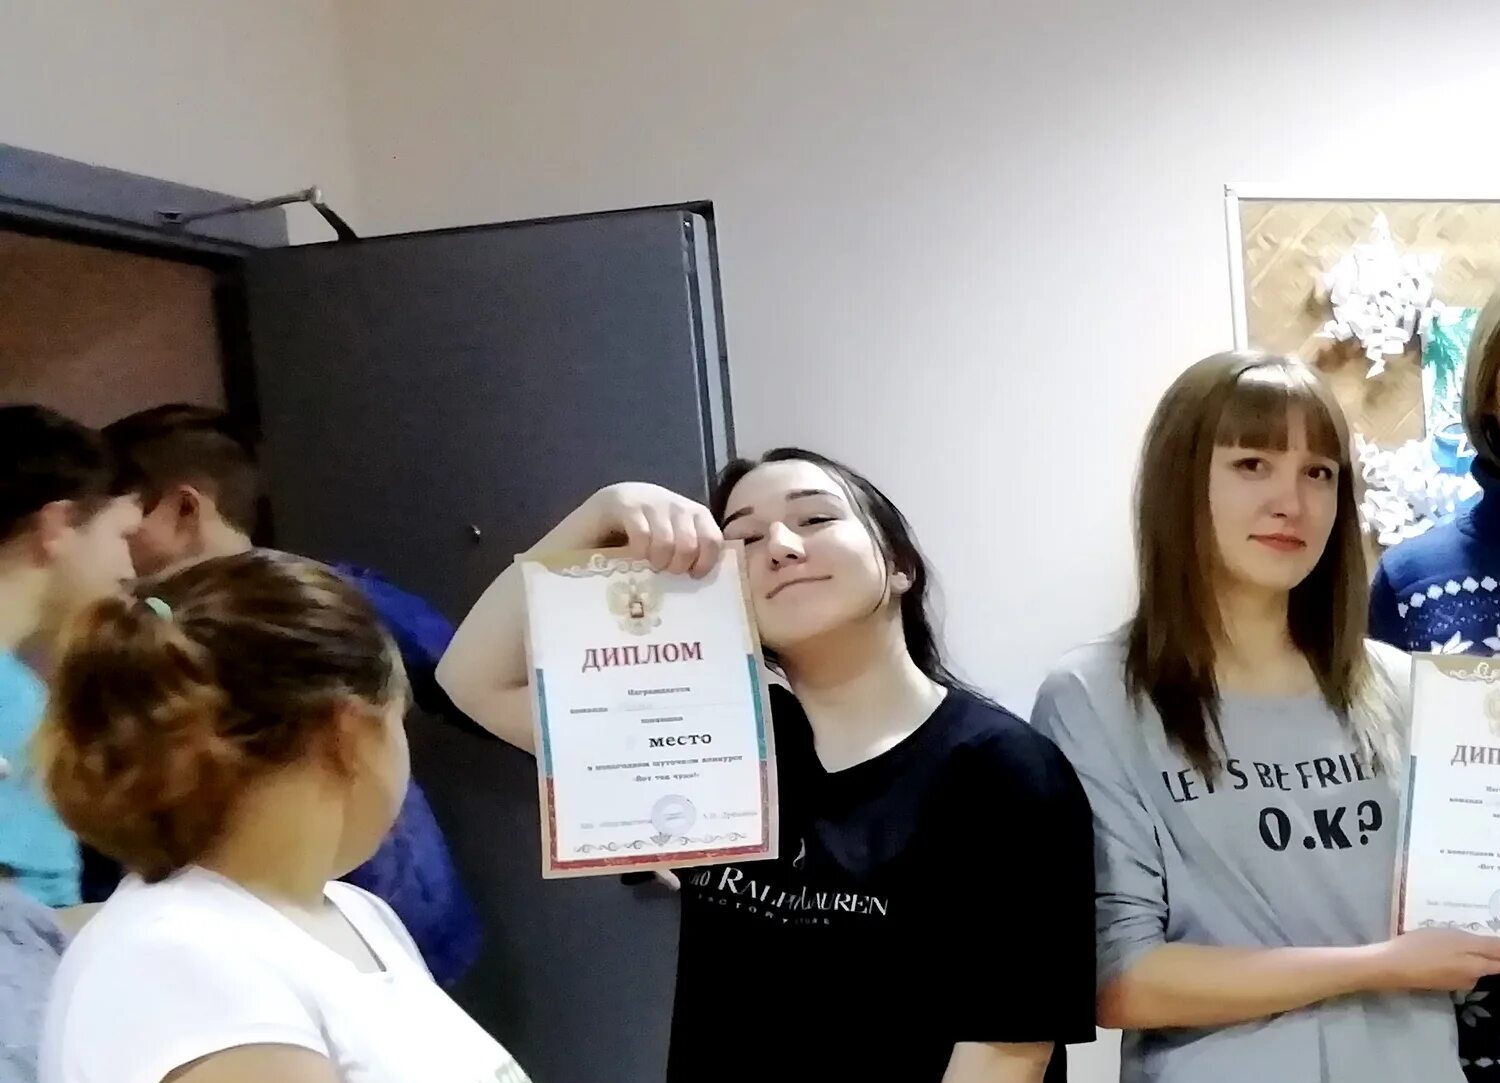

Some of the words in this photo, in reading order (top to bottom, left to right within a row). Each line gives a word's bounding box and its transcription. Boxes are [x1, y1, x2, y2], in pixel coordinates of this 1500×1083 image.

[581, 641, 704, 673] ДИПЛОМ
[648, 733, 712, 748] место
[1253, 762, 1291, 791] BE
[1259, 800, 1383, 851] O.K?
